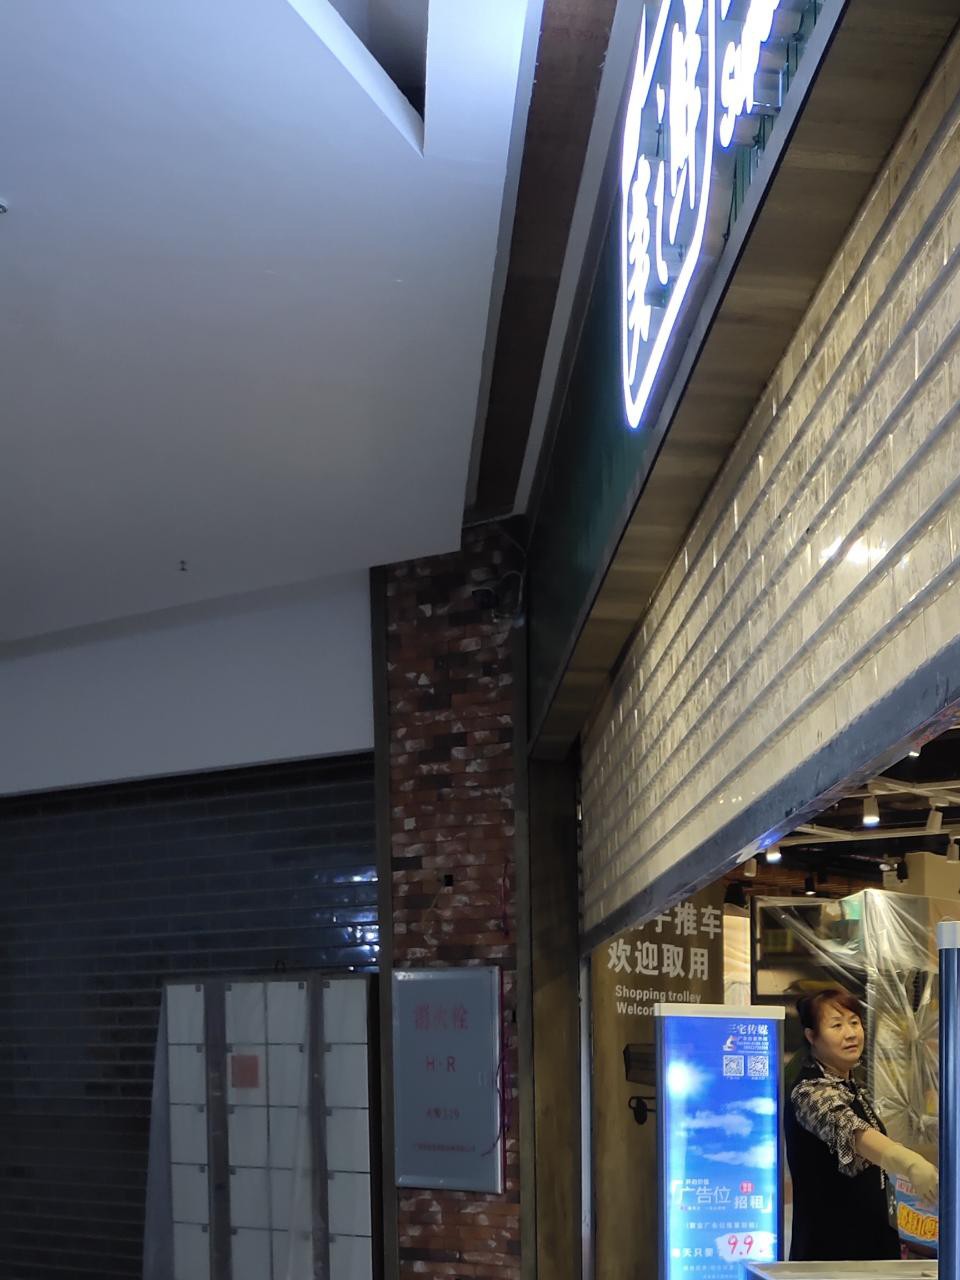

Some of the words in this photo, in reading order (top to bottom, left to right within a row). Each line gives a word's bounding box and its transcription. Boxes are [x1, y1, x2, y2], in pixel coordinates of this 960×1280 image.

[607, 938, 709, 981] 欢迎取用
[615, 985, 666, 1001] Shopping
[616, 1002, 655, 1016] Welco
[728, 1235, 753, 1255] 9.9
